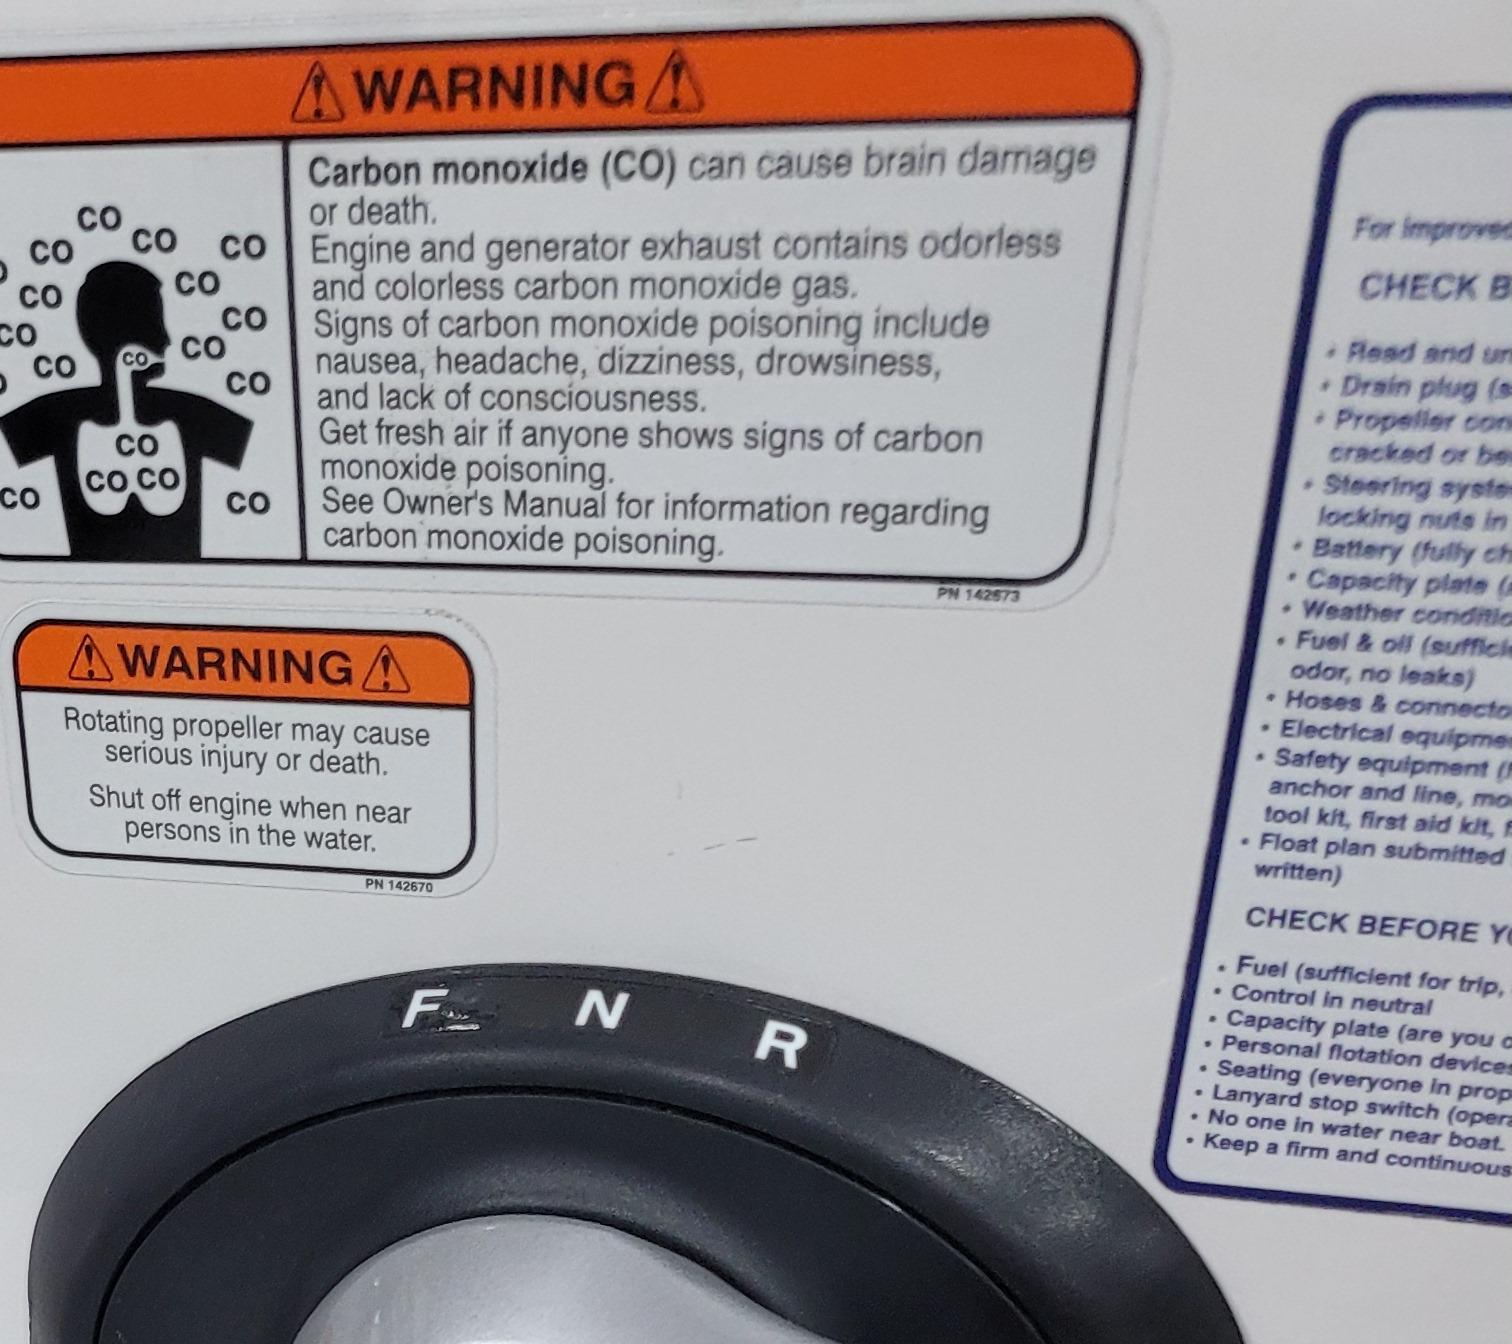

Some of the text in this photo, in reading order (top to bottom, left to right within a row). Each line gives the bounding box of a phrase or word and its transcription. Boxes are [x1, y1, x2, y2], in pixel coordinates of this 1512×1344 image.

[351, 59, 635, 113] WARNING
[308, 142, 1096, 189] Carbon monoxide (CO) can cause brain damage
[77, 205, 122, 231] CO
[220, 234, 266, 260] CO
[311, 224, 1061, 273] Engine and generator exhaust contains odorless
[0, 487, 41, 511] CO
[116, 643, 352, 686] WARNING
[63, 705, 429, 748] Rotating propeller may cause
[104, 743, 387, 776] serious injury or death.
[88, 783, 411, 824] Shut off engine when near
[124, 820, 375, 852] persons in the water.
[1258, 831, 1506, 866] Float plan submitted
[365, 877, 433, 892] PN 142670
[1245, 906, 1349, 933] CHECK
[1357, 914, 1479, 943] BEFORE
[401, 988, 450, 1029] F
[575, 989, 631, 1030] N
[1231, 983, 1433, 1015] Control in neutral
[754, 1019, 808, 1070] R
[1207, 1107, 1505, 1151] No one in water near boat.
